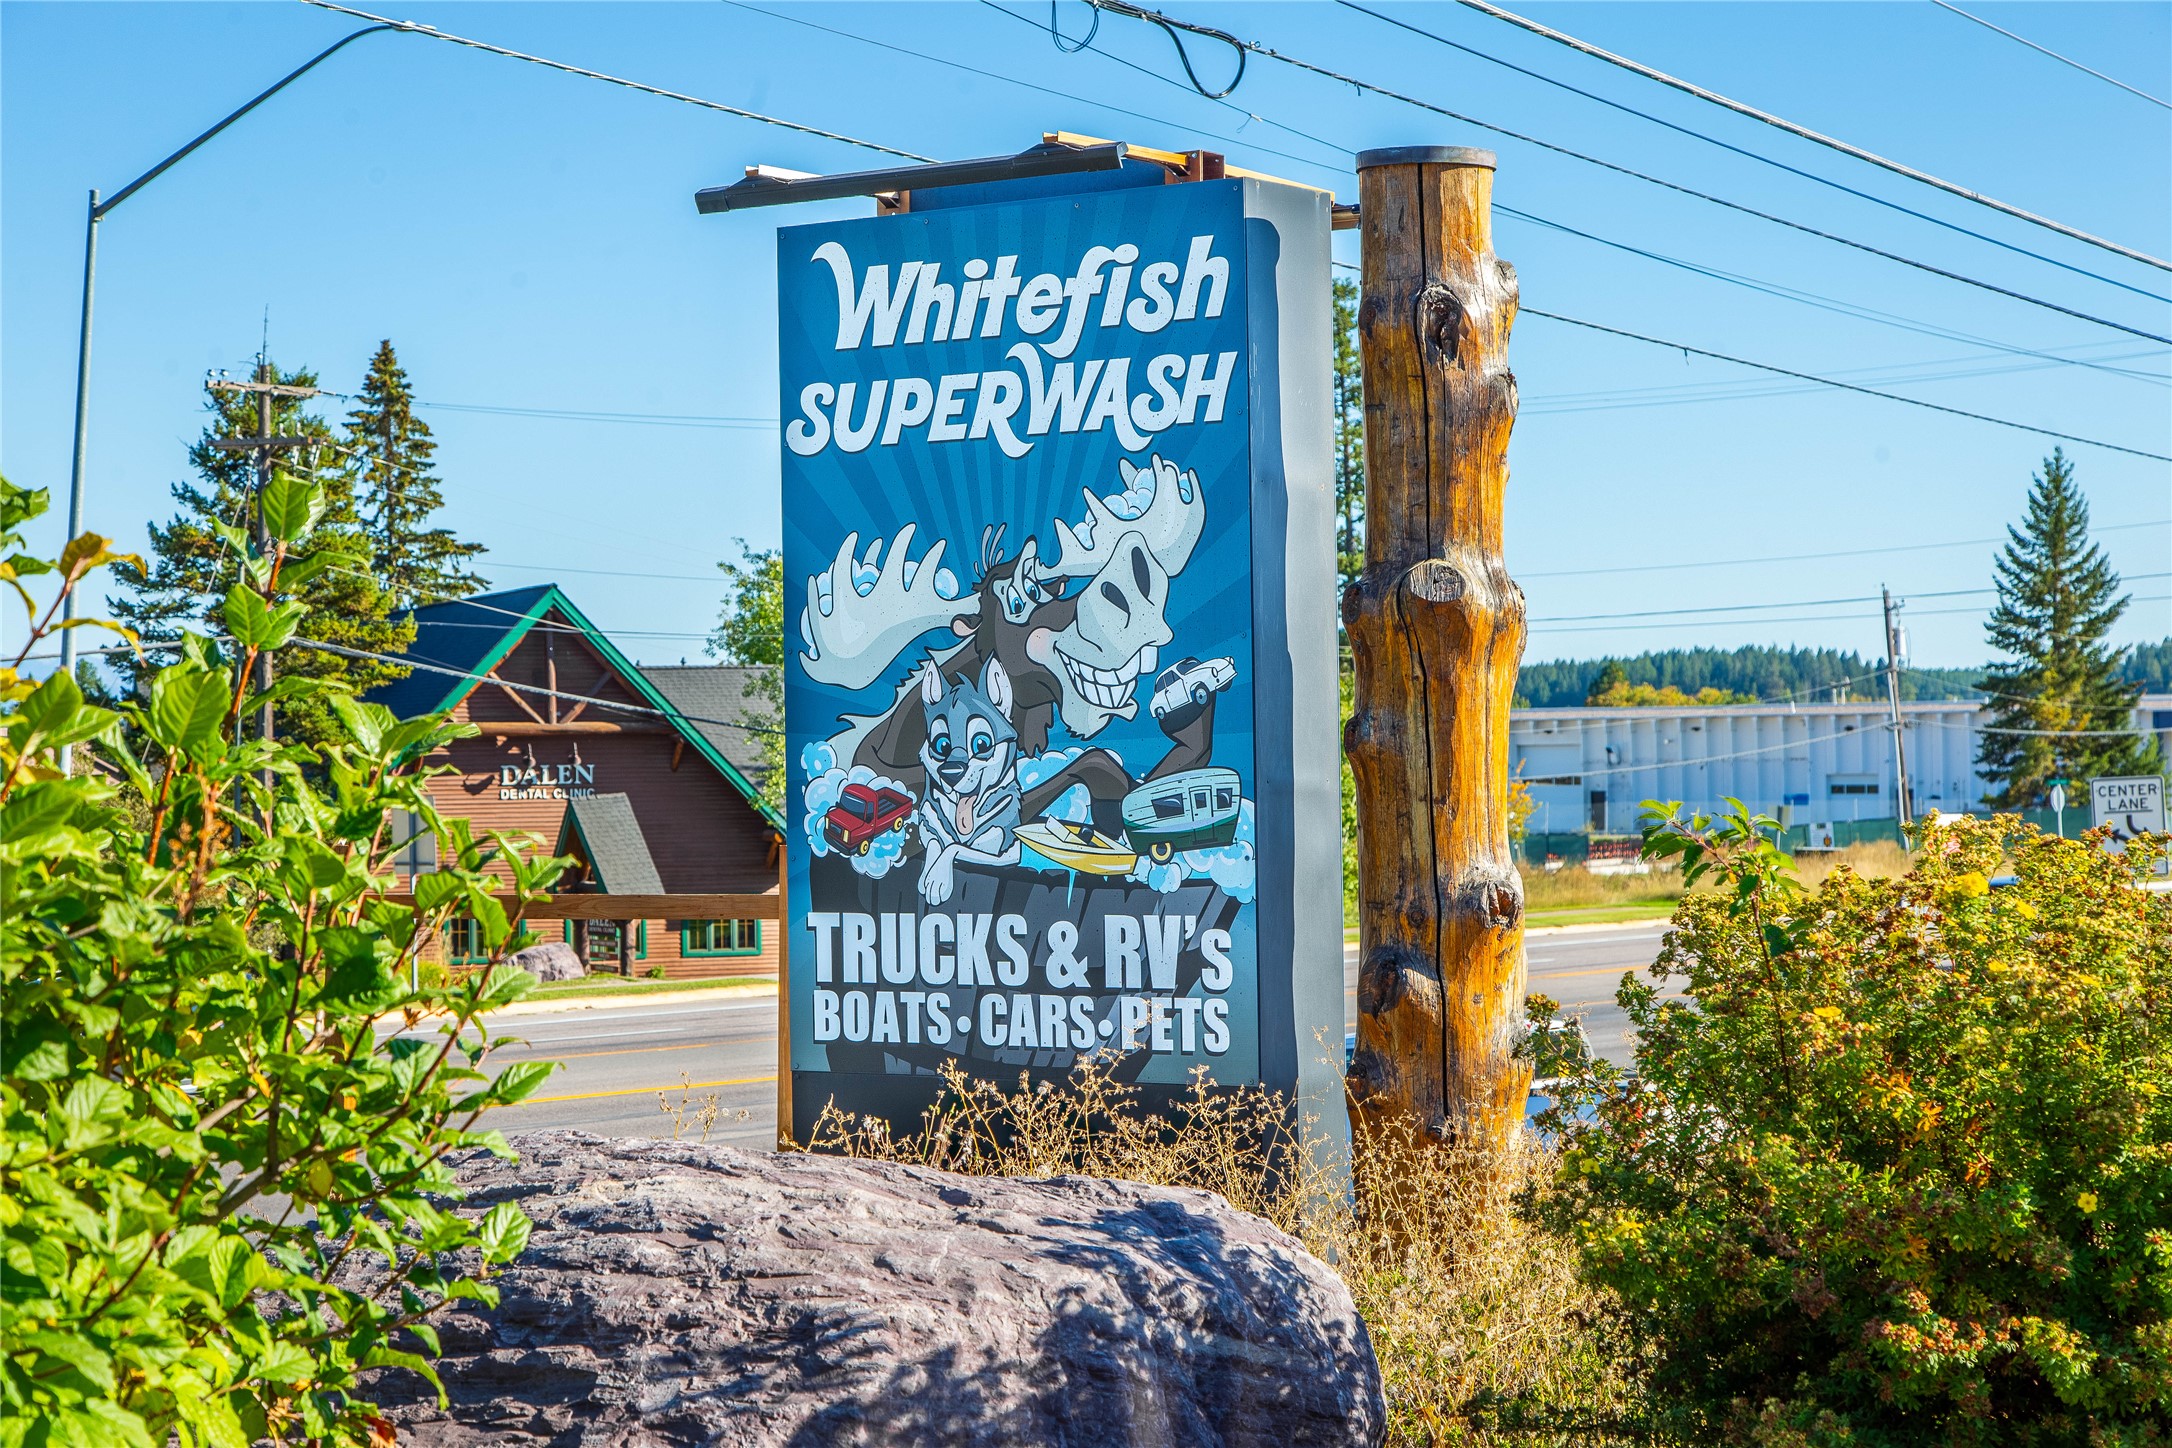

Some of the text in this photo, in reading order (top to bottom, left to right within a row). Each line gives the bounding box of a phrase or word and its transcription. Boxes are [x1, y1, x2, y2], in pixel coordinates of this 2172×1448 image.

[811, 235, 1230, 358] Whitefish
[786, 342, 1238, 459] SUPERWASH
[500, 764, 595, 786] DALEN
[500, 788, 595, 800] DENTAL CLINIC
[2098, 784, 2157, 798] CENTER
[2108, 798, 2149, 810] LANE
[807, 912, 1030, 987] TRUCKS
[1046, 920, 1091, 989] &
[813, 989, 1230, 1052] BOATS CARS PETS
